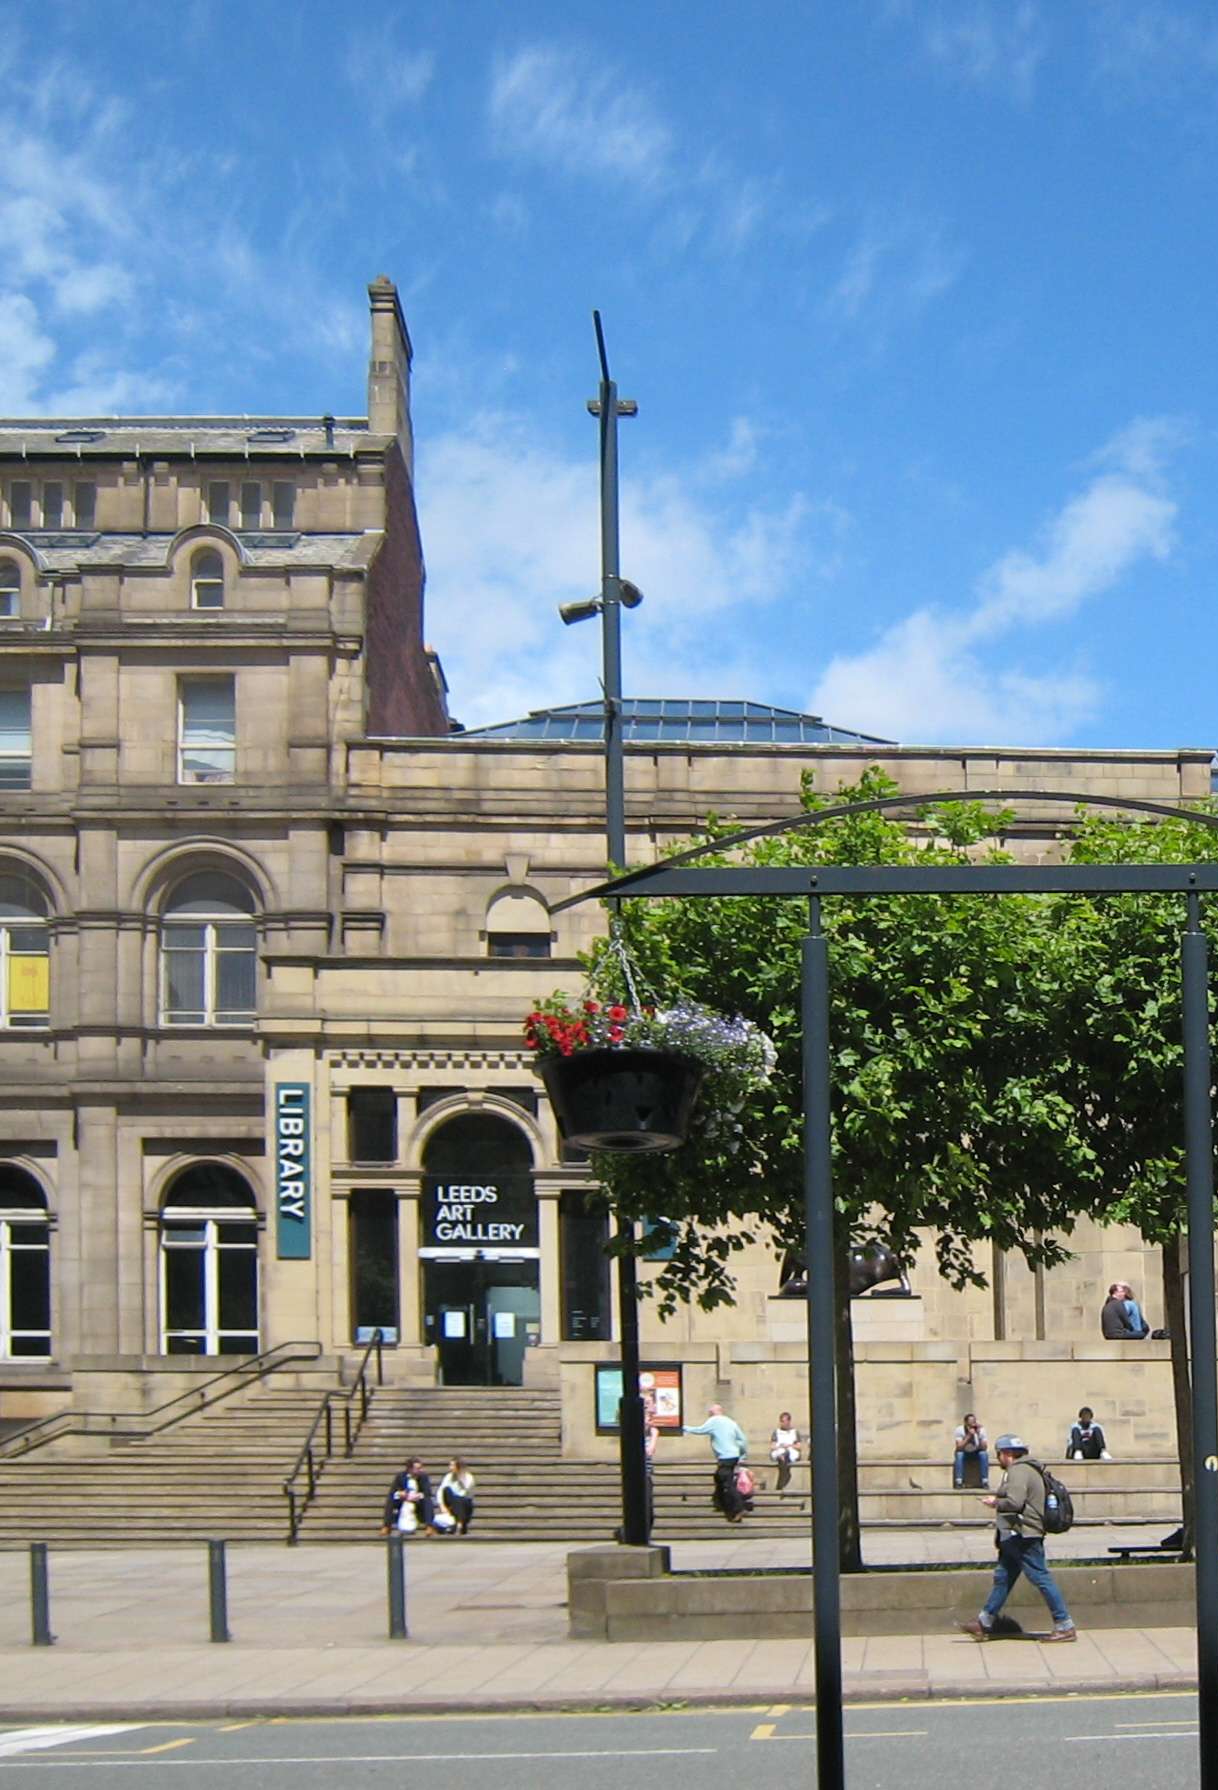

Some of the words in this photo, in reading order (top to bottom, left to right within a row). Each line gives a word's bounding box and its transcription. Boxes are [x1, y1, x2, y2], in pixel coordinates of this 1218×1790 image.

[279, 1088, 304, 1217] LIBRARY
[437, 1185, 498, 1203] LEEDS
[436, 1204, 475, 1221] ART
[435, 1222, 525, 1241] GALLERY
